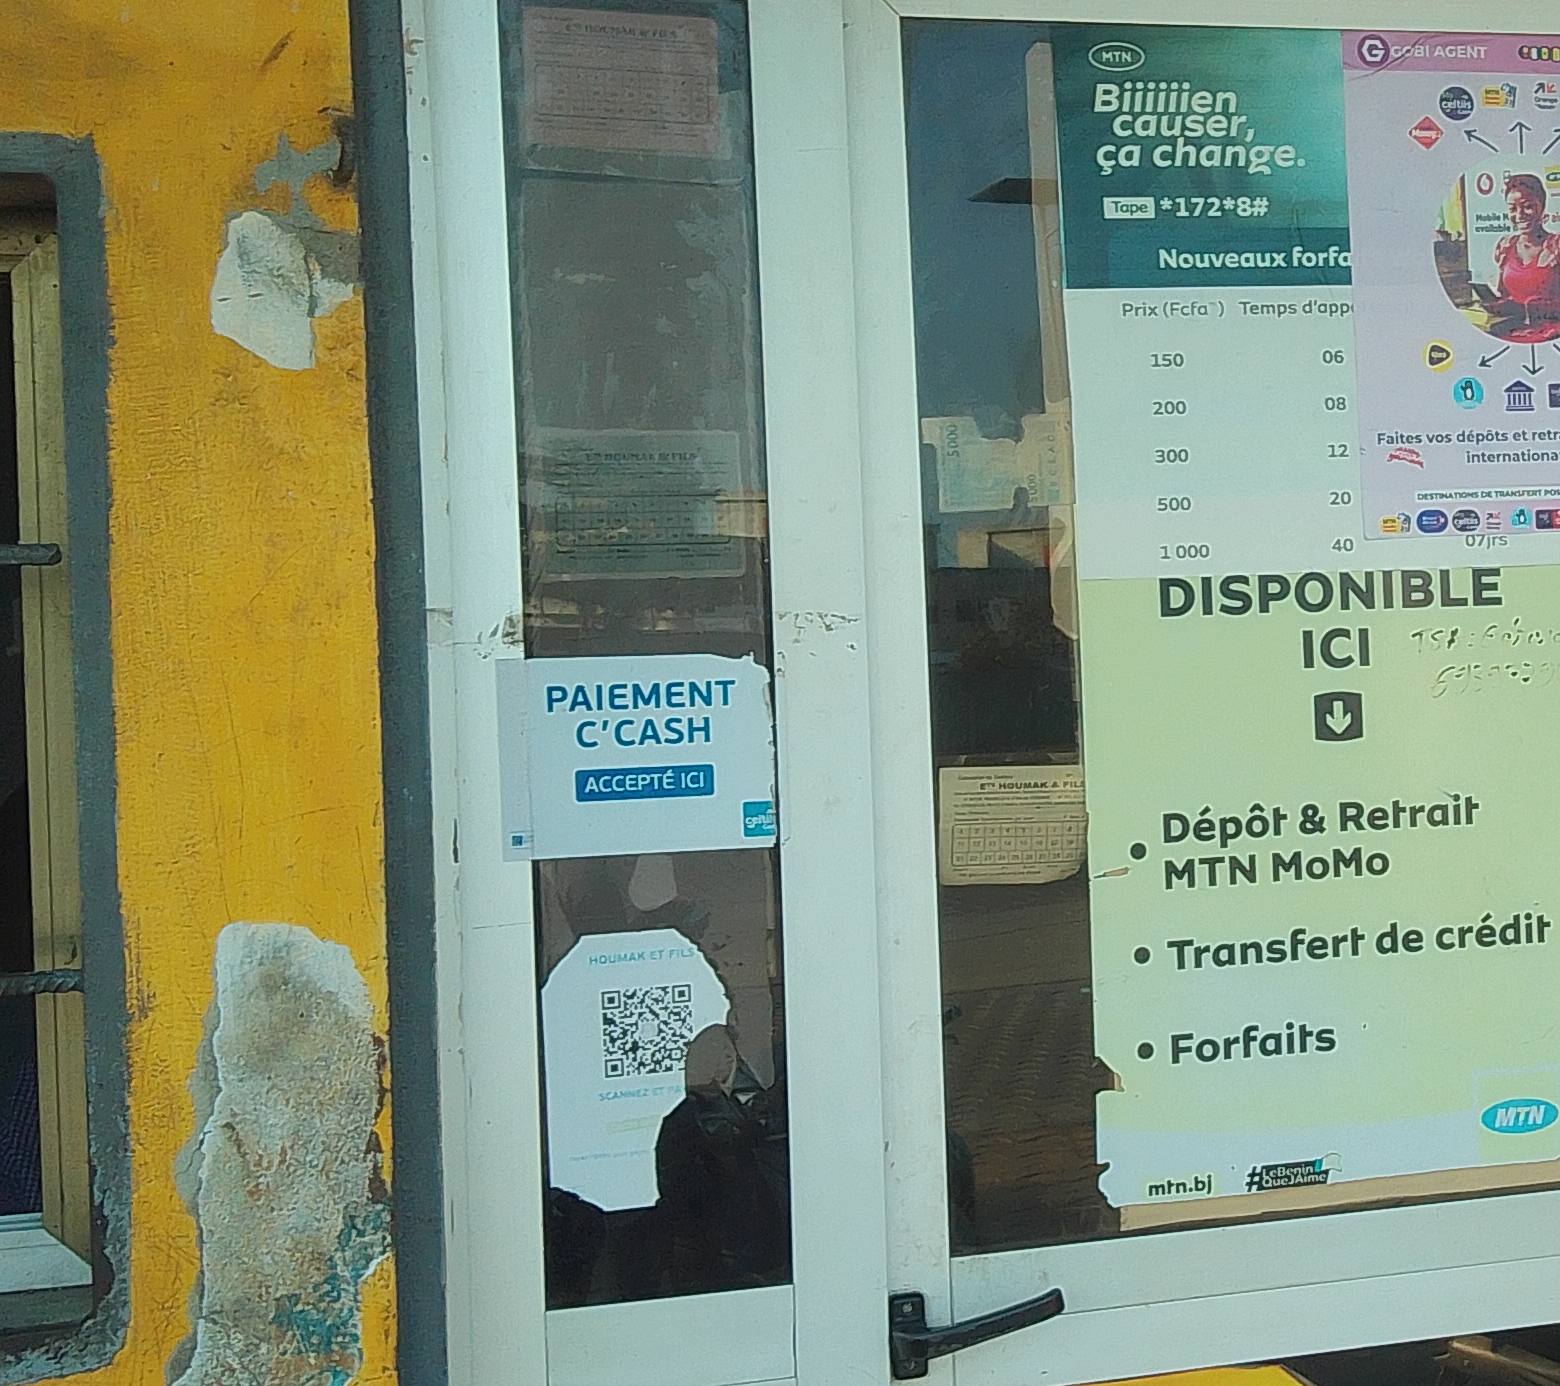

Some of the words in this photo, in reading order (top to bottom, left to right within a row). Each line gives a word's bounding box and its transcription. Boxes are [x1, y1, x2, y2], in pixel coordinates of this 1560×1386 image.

[1101, 51, 1133, 63] MTN
[1391, 45, 1430, 58] GOBI
[1434, 46, 1487, 59] AGENT
[1113, 114, 1255, 142] causer,
[1096, 144, 1141, 175] ça
[1153, 137, 1306, 174] change.
[1111, 201, 1149, 215] Tape
[1159, 248, 1287, 269] Nouveaux
[1292, 245, 1352, 267] forfa
[1121, 303, 1158, 317] Prix
[1238, 301, 1297, 318] Temps
[1302, 299, 1354, 318] d'app
[1150, 353, 1184, 368] 150
[1322, 349, 1345, 364] 06
[1152, 401, 1187, 415] 200
[1324, 397, 1347, 411] 08
[1376, 432, 1422, 444] Faites
[1426, 433, 1452, 443] vos
[1456, 430, 1508, 444] dépôts
[1513, 430, 1528, 441] et
[1154, 449, 1189, 464] 300
[1327, 444, 1349, 458] 12
[1157, 497, 1191, 511] 500
[1329, 491, 1352, 505] 20
[1331, 538, 1354, 552] 40
[1158, 568, 1503, 617] DISPONIBLE
[1302, 627, 1371, 669] ICI
[545, 679, 738, 712] PAIEMENT
[575, 716, 712, 749] C'CASH
[584, 769, 675, 794] ACCEPTÉ
[681, 772, 706, 789] ICI
[1161, 803, 1288, 848] Dépôt
[1298, 803, 1326, 835] &
[1339, 794, 1481, 833] Retrait
[1164, 855, 1258, 890] MTN
[1271, 848, 1390, 883] MoMo
[1167, 928, 1366, 970] Transfert
[1375, 921, 1424, 954] de
[1436, 911, 1552, 950] crédit
[589, 952, 646, 965] HOUMAK
[650, 950, 664, 961] ET
[669, 948, 696, 958] FILS
[1169, 1021, 1337, 1064] Forfaits
[1495, 1106, 1545, 1128] MTN
[1148, 1175, 1213, 1198] mtn.bj
